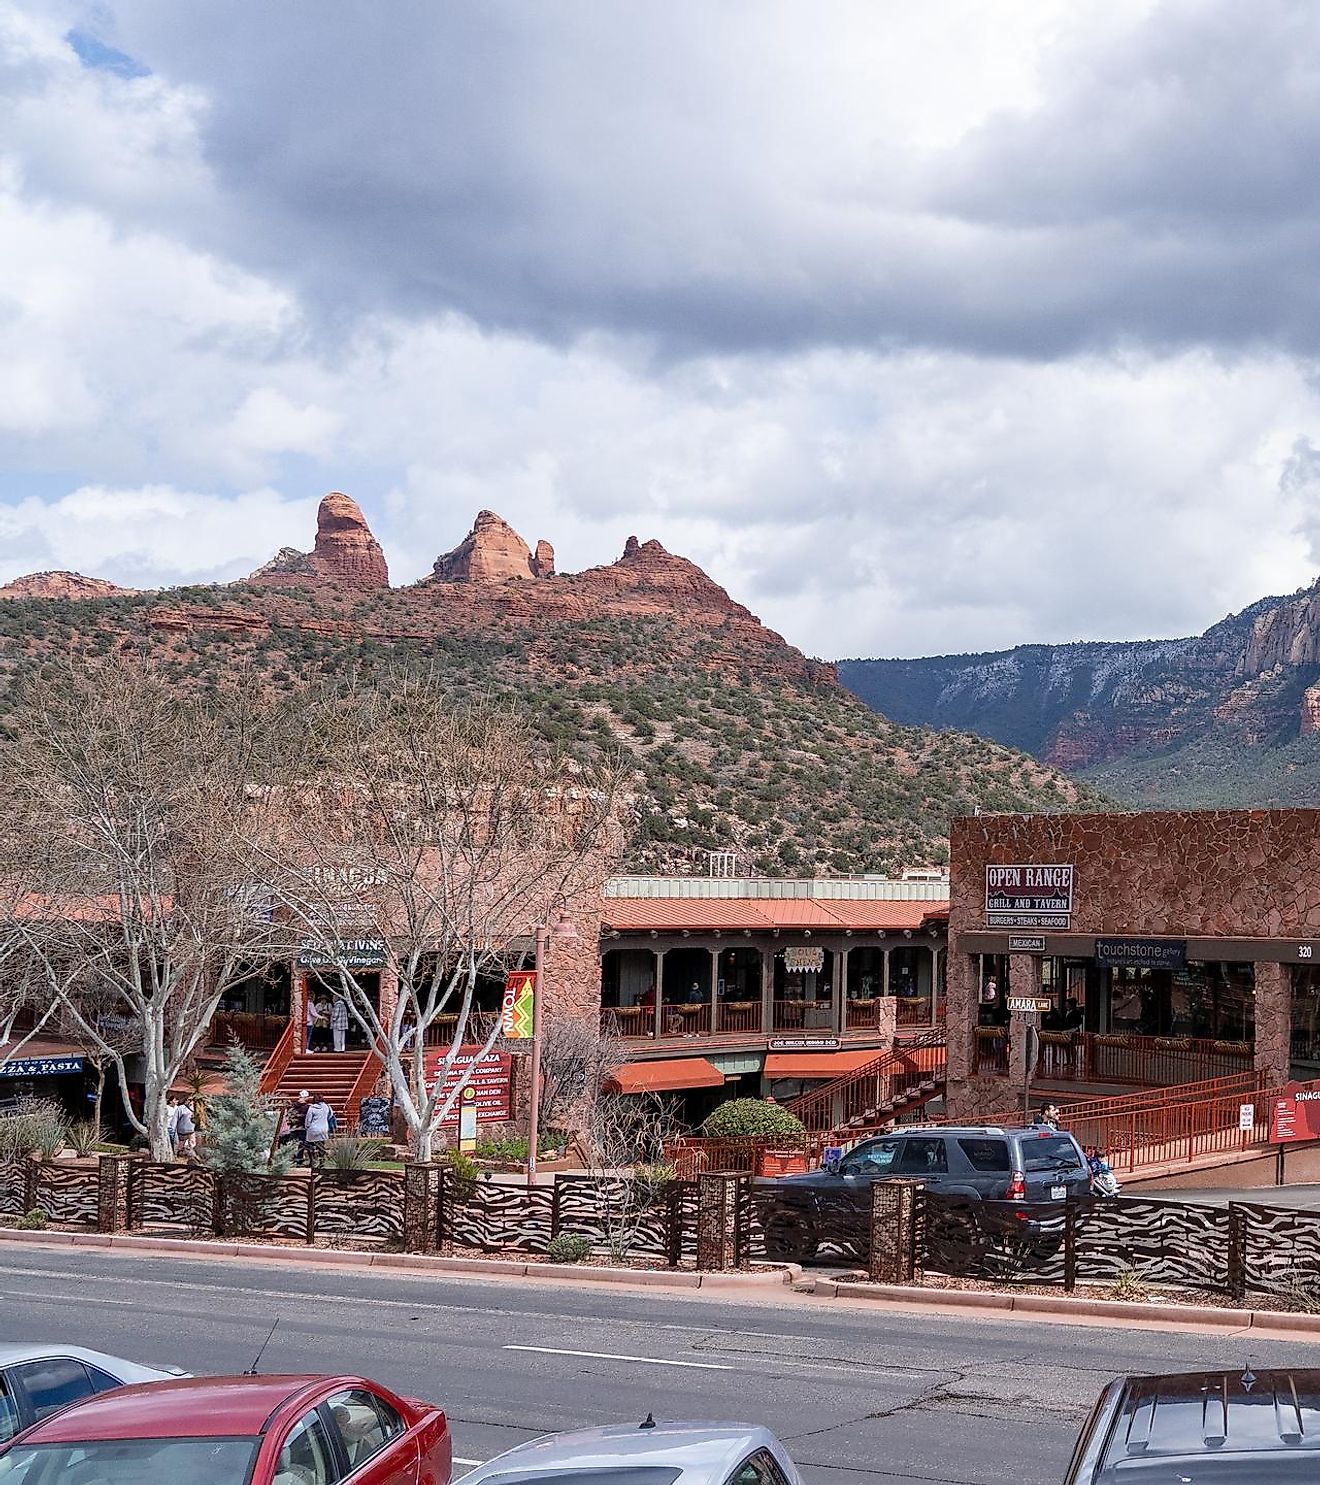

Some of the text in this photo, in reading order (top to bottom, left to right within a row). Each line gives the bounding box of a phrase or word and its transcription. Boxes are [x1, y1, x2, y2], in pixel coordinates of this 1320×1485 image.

[989, 868, 1070, 887] OPEN RANGE
[988, 898, 1067, 909] GRILL AND TAVERN
[1096, 941, 1162, 959] touchstone
[1299, 946, 1312, 958] 320
[503, 987, 517, 1032] TOWN
[1010, 999, 1036, 1010] AMARA
[437, 1056, 474, 1065] SIAGUA
[41, 1062, 81, 1071] PASTA
